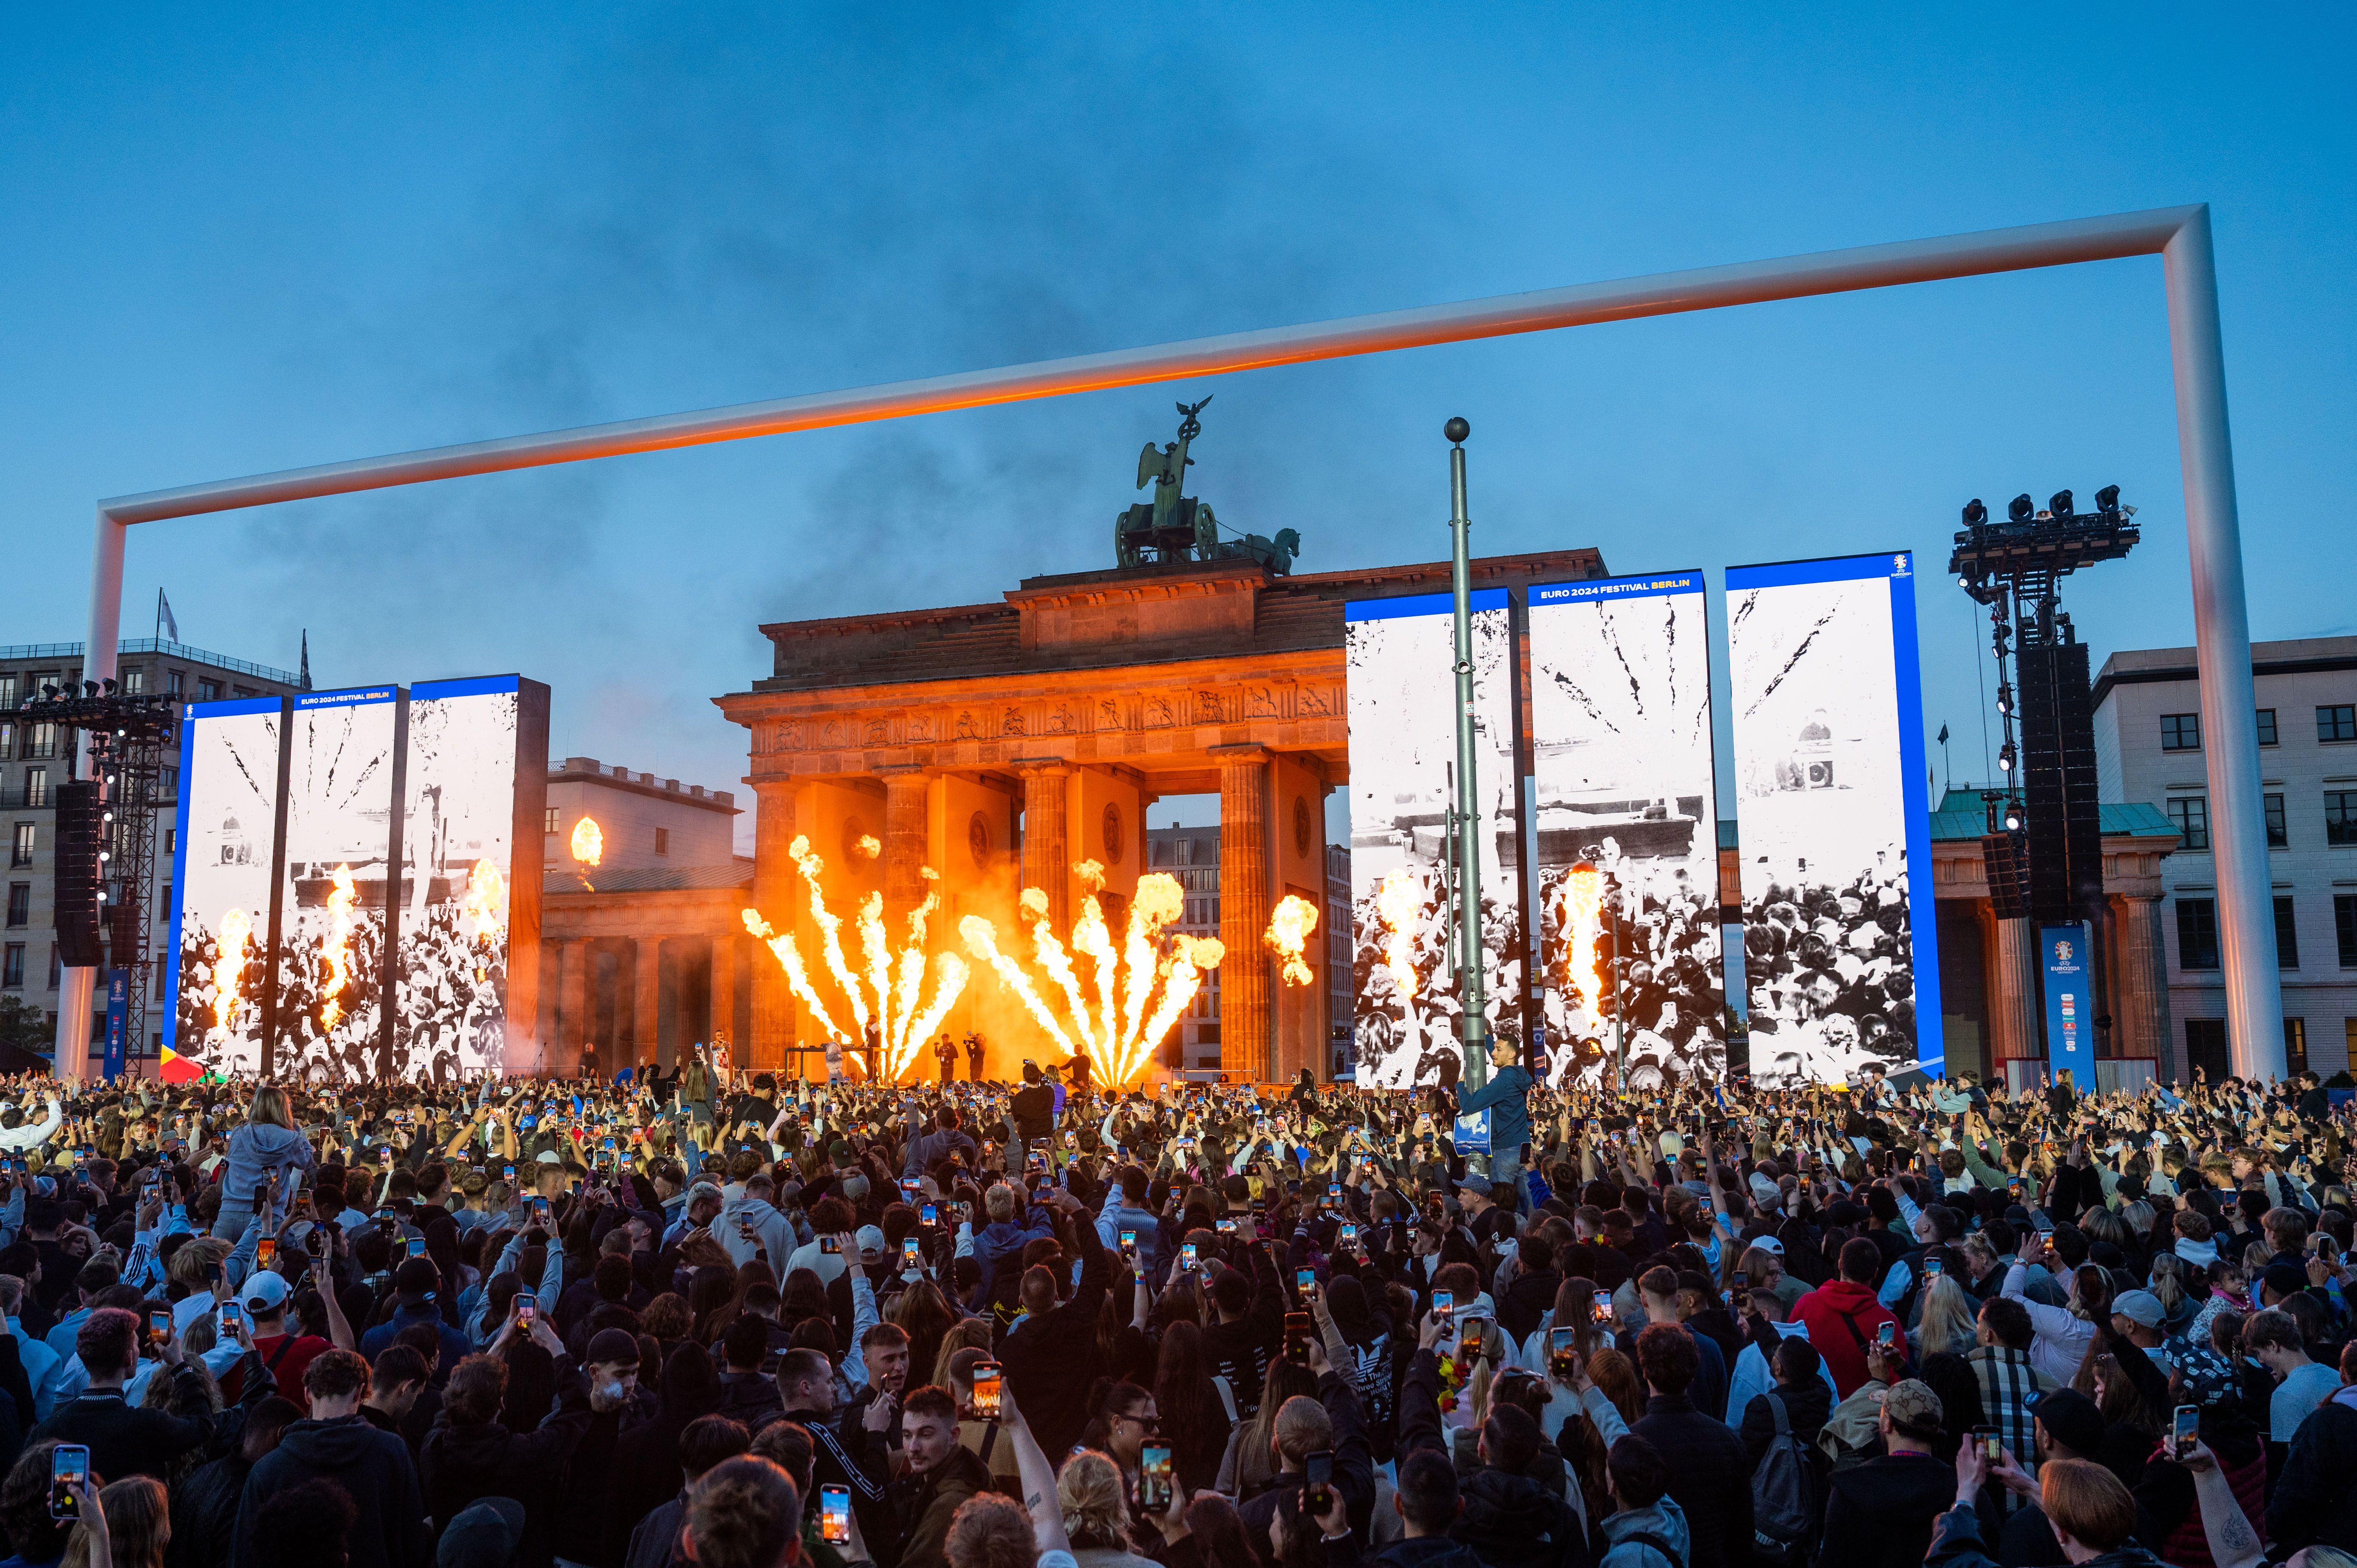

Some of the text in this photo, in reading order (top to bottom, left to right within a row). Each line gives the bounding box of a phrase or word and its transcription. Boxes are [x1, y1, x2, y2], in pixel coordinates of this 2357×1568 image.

[1541, 579, 1690, 599] EURO 2024 FESTIVAL BERLIN
[336, 694, 365, 702] FESTIVAL
[1368, 1372, 1381, 1381] The
[1358, 1382, 1375, 1392] hree
